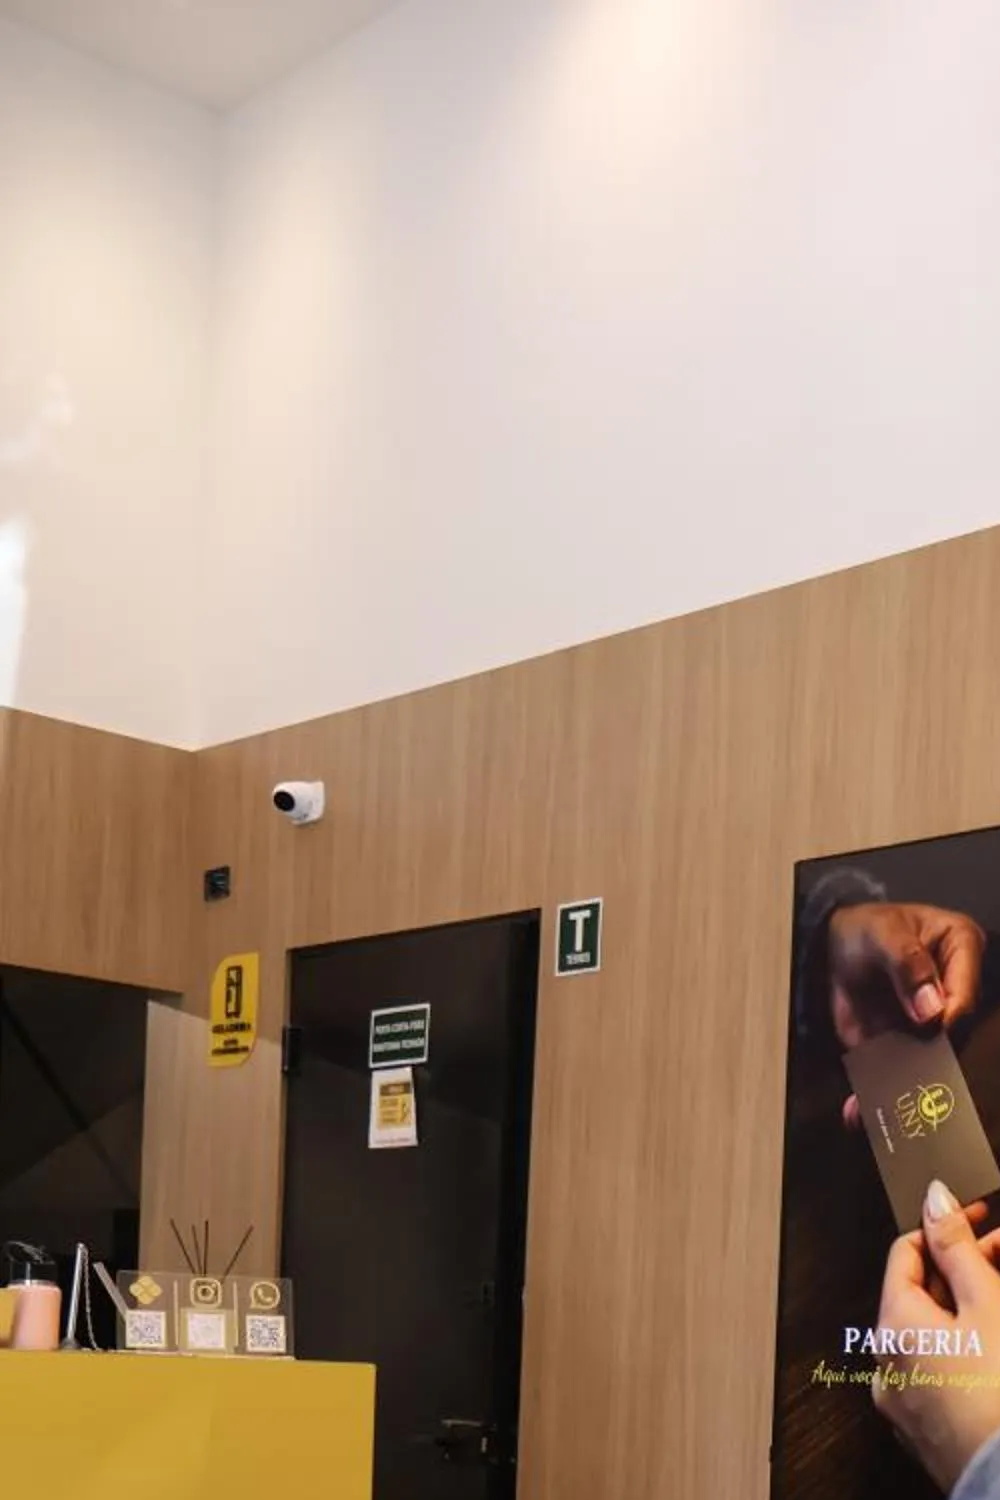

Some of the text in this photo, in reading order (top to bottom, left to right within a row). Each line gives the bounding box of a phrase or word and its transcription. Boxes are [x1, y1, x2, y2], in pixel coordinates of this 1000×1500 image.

[568, 909, 591, 953] T
[843, 1326, 983, 1357] PARCERIA
[811, 1359, 847, 1391] Aqui
[880, 1361, 907, 1392] faz
